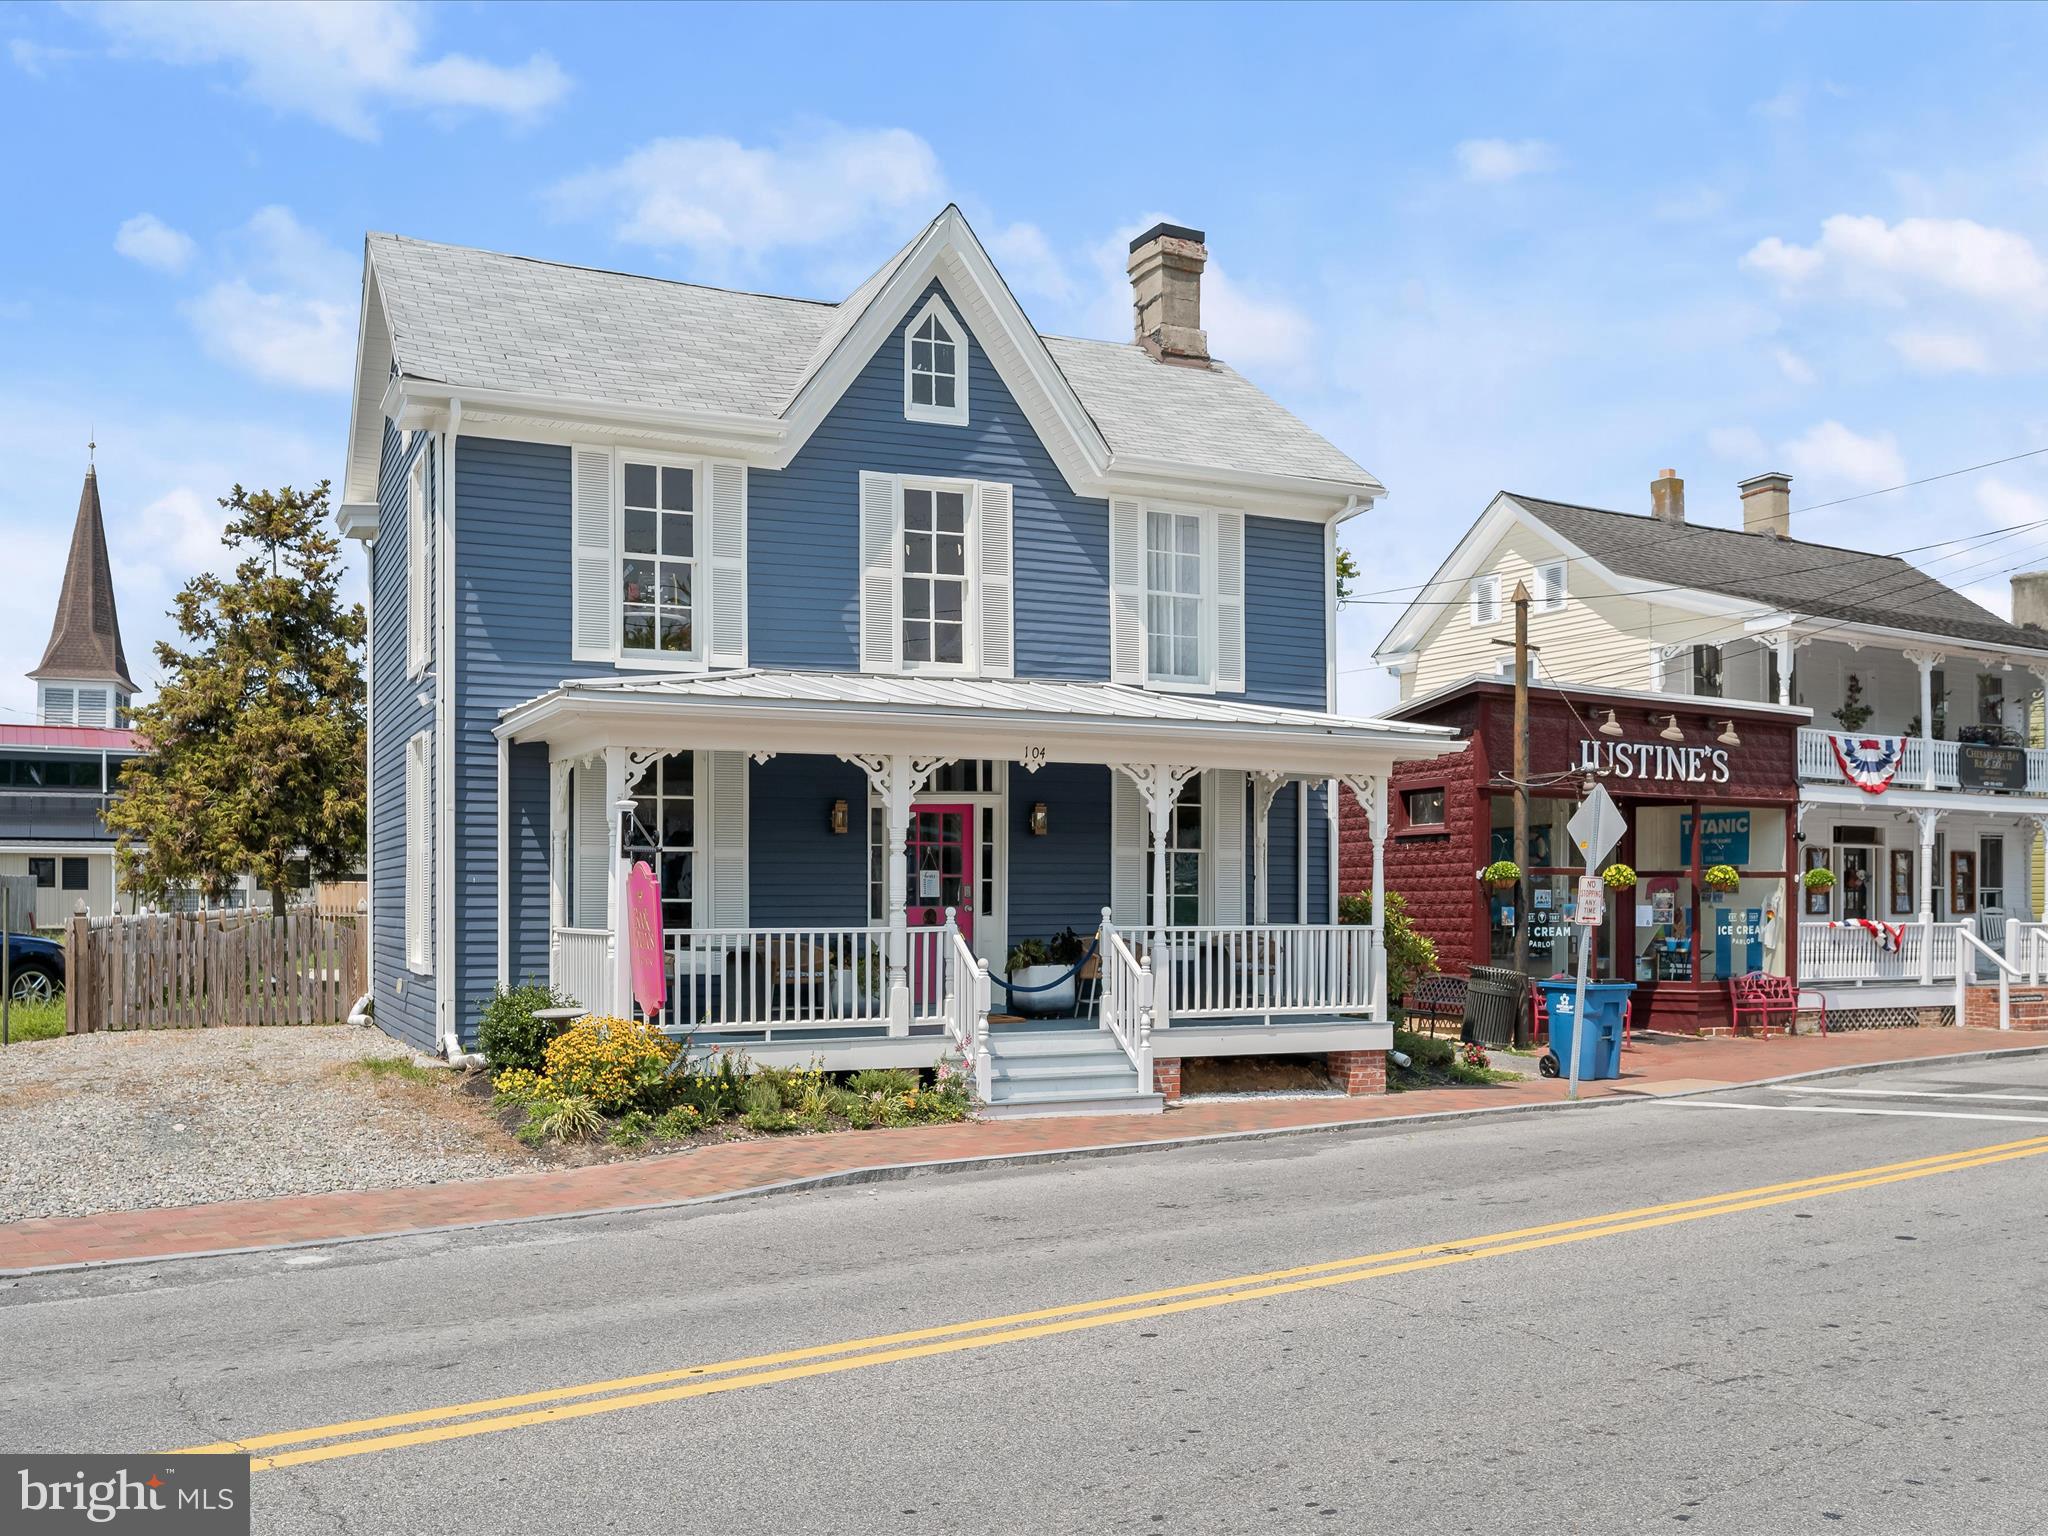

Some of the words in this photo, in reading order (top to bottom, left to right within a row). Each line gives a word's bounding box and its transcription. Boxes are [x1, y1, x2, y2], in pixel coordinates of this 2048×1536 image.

[1025, 745, 1046, 760] 104
[1571, 740, 1730, 783] JUSTINE'S
[1682, 817, 1749, 835] TTANIC
[1586, 880, 1597, 889] NO
[1533, 926, 1571, 937] CREAM
[1717, 925, 1733, 936] ICE
[1736, 925, 1761, 935] CREA
[1528, 939, 1555, 948] PARLOR
